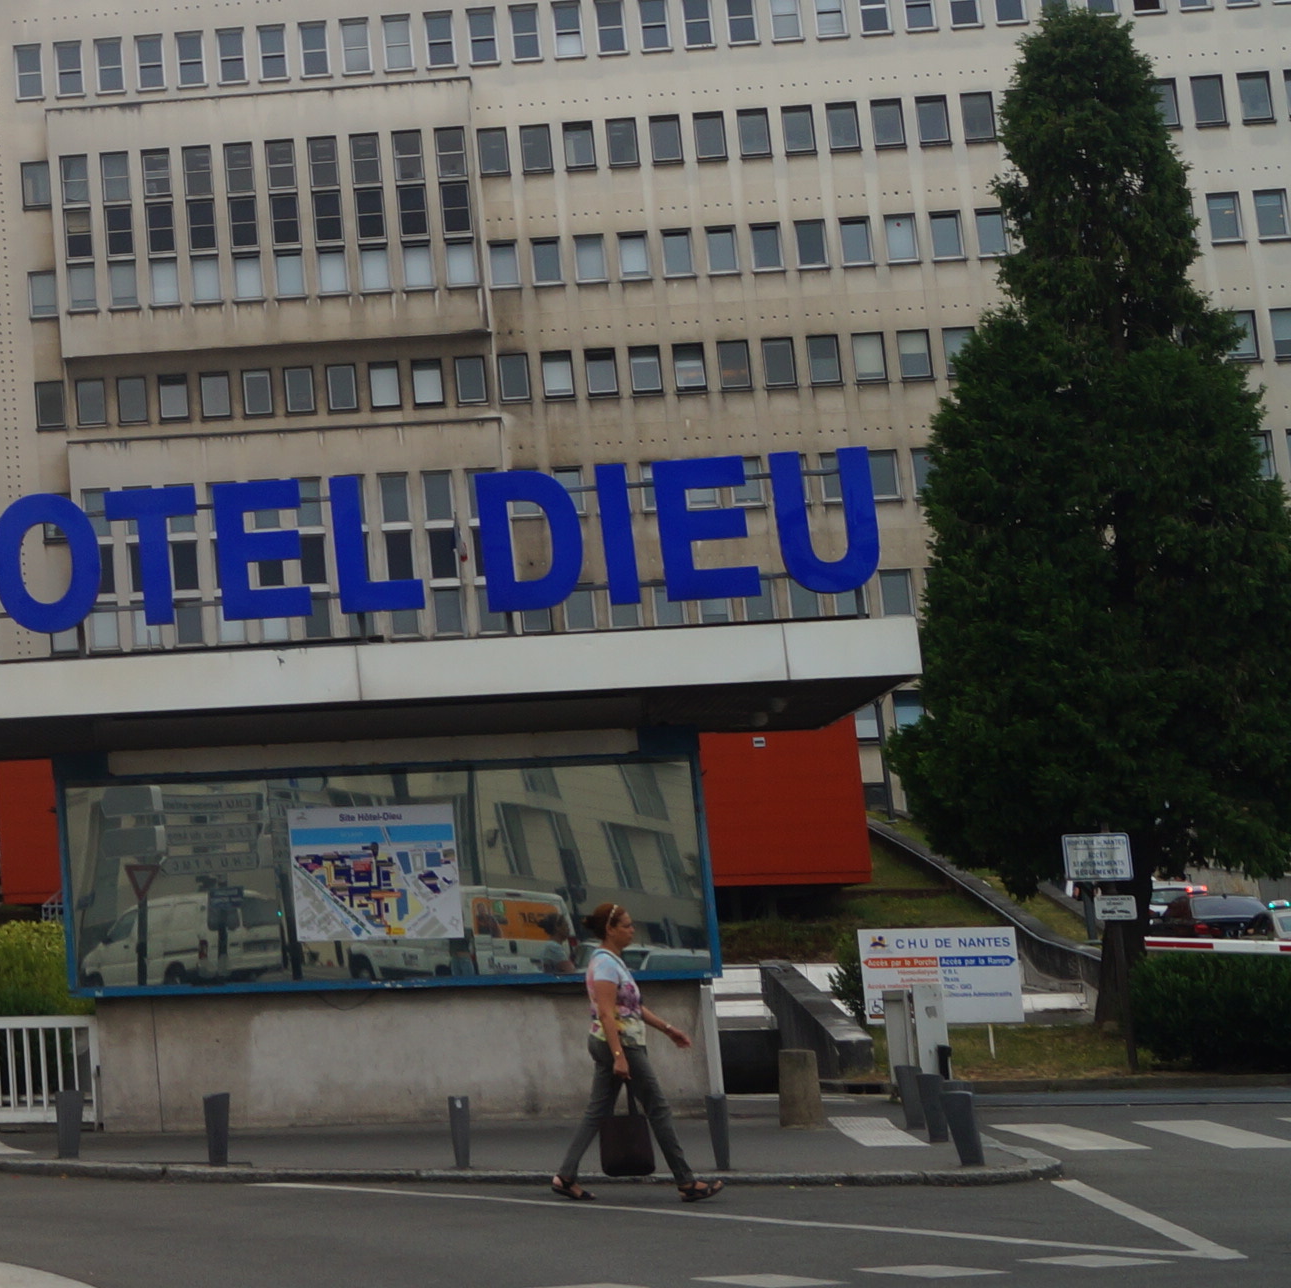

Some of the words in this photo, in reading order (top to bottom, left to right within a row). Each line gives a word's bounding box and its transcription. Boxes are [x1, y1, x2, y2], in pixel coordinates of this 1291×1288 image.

[338, 813, 356, 822] Site
[357, 811, 403, 822] Hôtel-Dieu
[934, 937, 952, 948] DE
[958, 936, 1011, 948] NANTES
[867, 958, 889, 967] Accès
[890, 959, 902, 968] par
[904, 958, 911, 966] le
[913, 958, 938, 966] Porche
[941, 957, 962, 966] Accès
[964, 958, 976, 967] par
[987, 956, 1012, 966] Rampe
